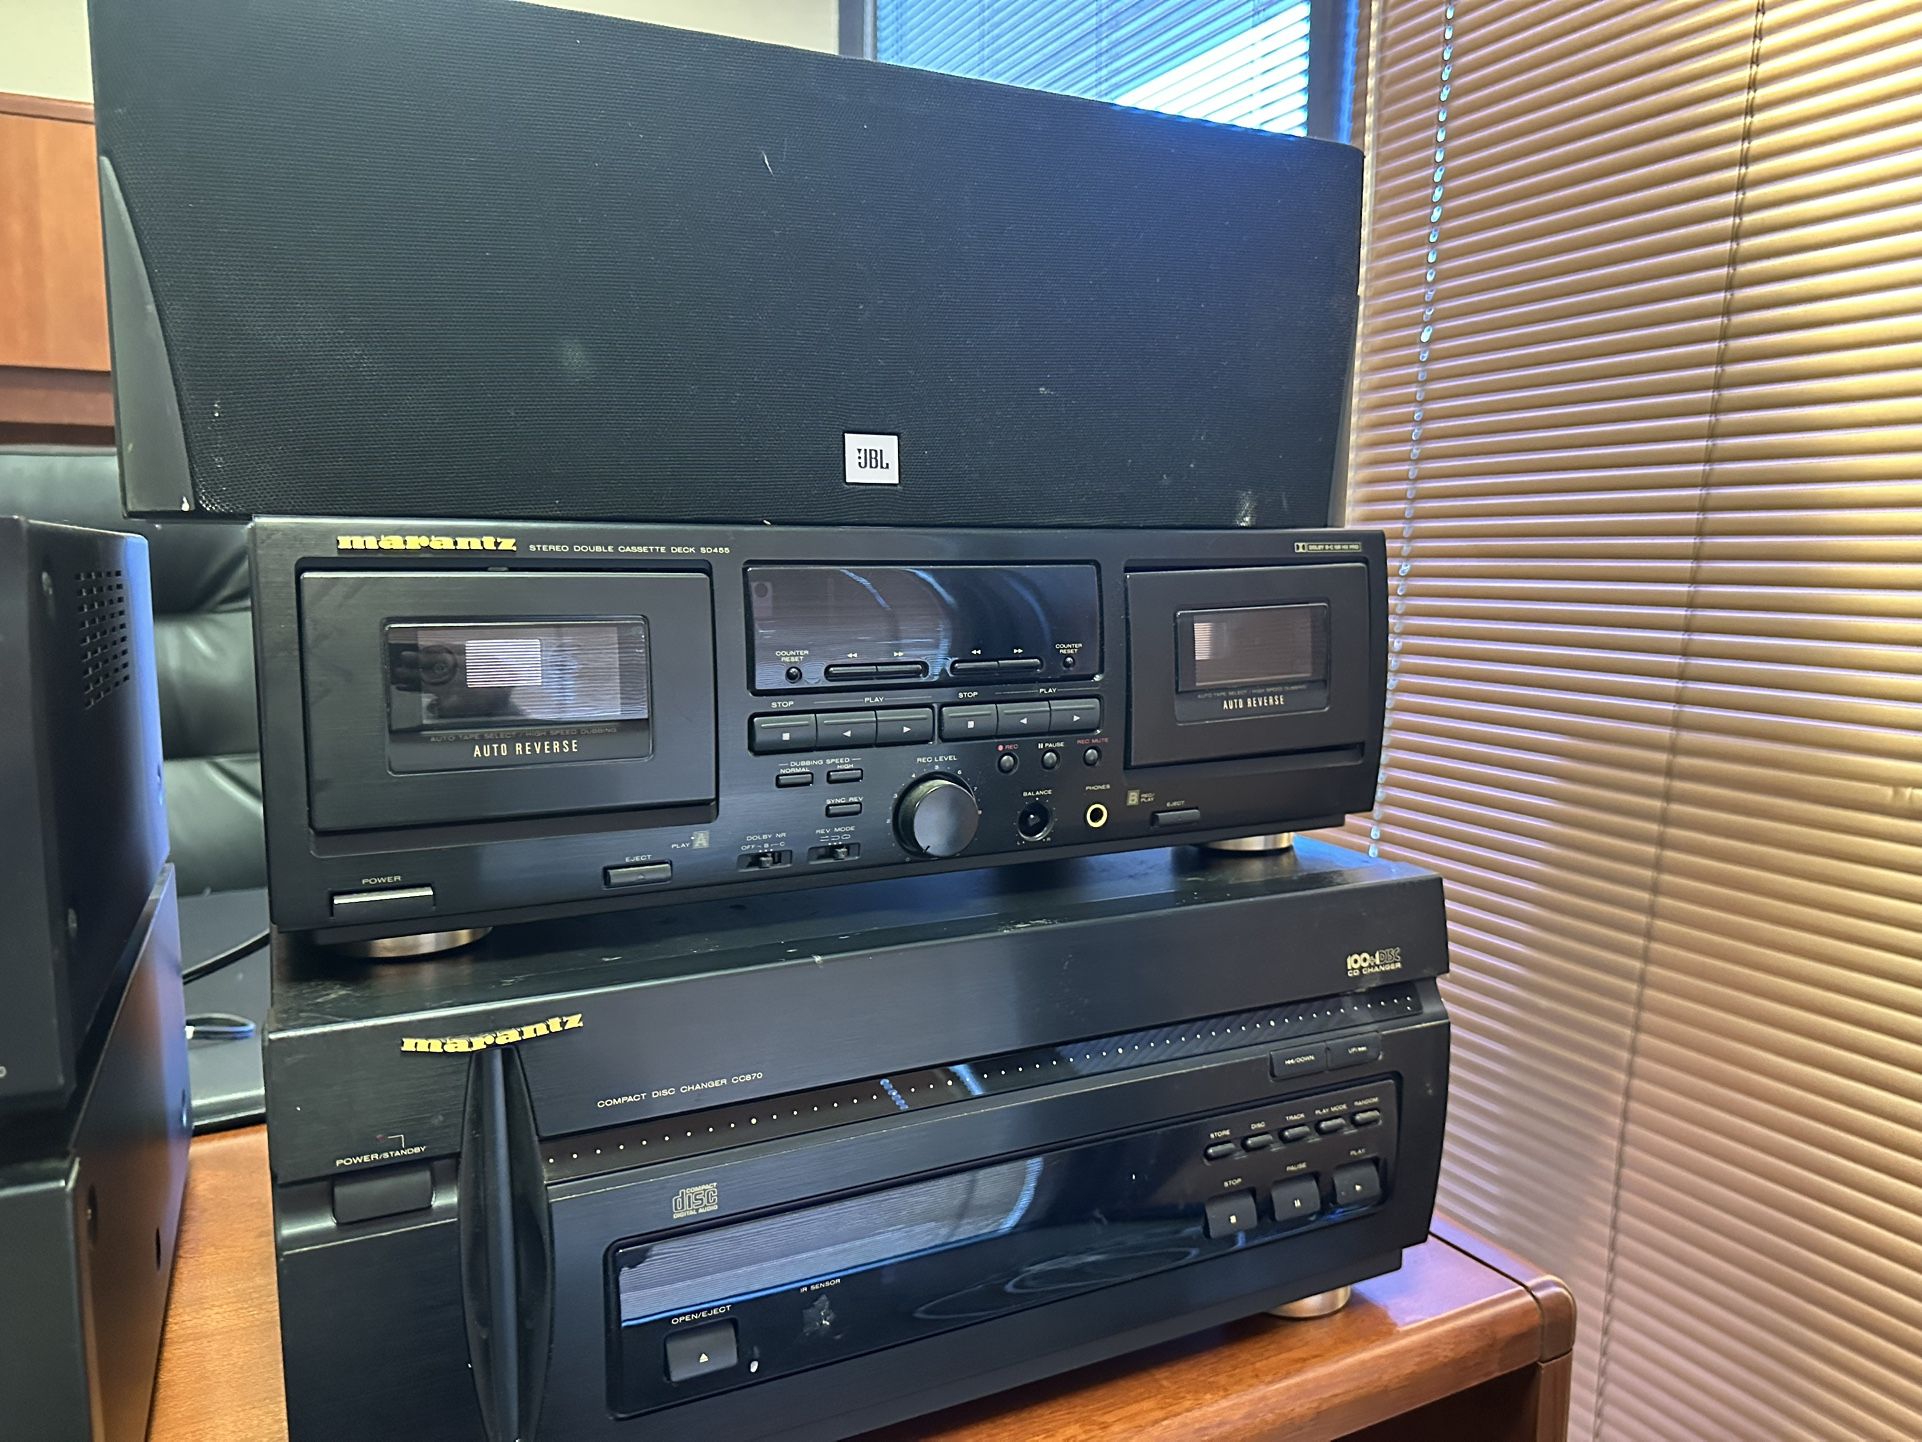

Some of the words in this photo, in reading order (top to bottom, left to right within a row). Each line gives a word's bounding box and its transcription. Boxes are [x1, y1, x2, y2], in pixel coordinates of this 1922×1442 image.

[857, 448, 890, 470] JBL
[337, 535, 517, 551] marantz
[529, 544, 569, 552] STEREO
[573, 545, 614, 553] DOUBLE
[671, 546, 696, 554] DECK
[958, 691, 978, 699] STOP
[1223, 698, 1243, 710] AUTO
[1247, 695, 1284, 708] REVERSE
[430, 734, 456, 742] AUTO
[484, 731, 516, 739] SELECT
[550, 728, 577, 736] SPEED
[473, 743, 507, 758] AUTO
[515, 740, 578, 755] REVERSE
[790, 759, 823, 767] DUBBING
[1023, 789, 1053, 797] BALANCE
[746, 833, 772, 841] DOLBY
[625, 854, 652, 862] EJECT
[362, 875, 401, 885] POWER
[1347, 969, 1360, 977] CD
[1362, 962, 1402, 974] CHANGER
[401, 1013, 584, 1053] marantz
[597, 1093, 647, 1108] COMPACT
[652, 1088, 676, 1098] DISC
[680, 1078, 727, 1093] CHANGER
[1354, 1097, 1379, 1106] RANDOM
[1315, 1107, 1329, 1115] PLAY
[1285, 1113, 1305, 1121] TRACK
[1251, 1121, 1266, 1129] DISC
[1210, 1129, 1231, 1139] STORE
[336, 1145, 427, 1167] POWER/STANDBY
[1286, 1162, 1307, 1171] PAUSE
[686, 1182, 717, 1193] COMPACT
[1224, 1178, 1242, 1187] STOP
[672, 1188, 718, 1213] disc
[673, 1210, 697, 1219] DIGITAL
[698, 1204, 718, 1213] AUDIO
[810, 1278, 841, 1291] SENSOR
[671, 1304, 732, 1325] OPEN/EJECT
